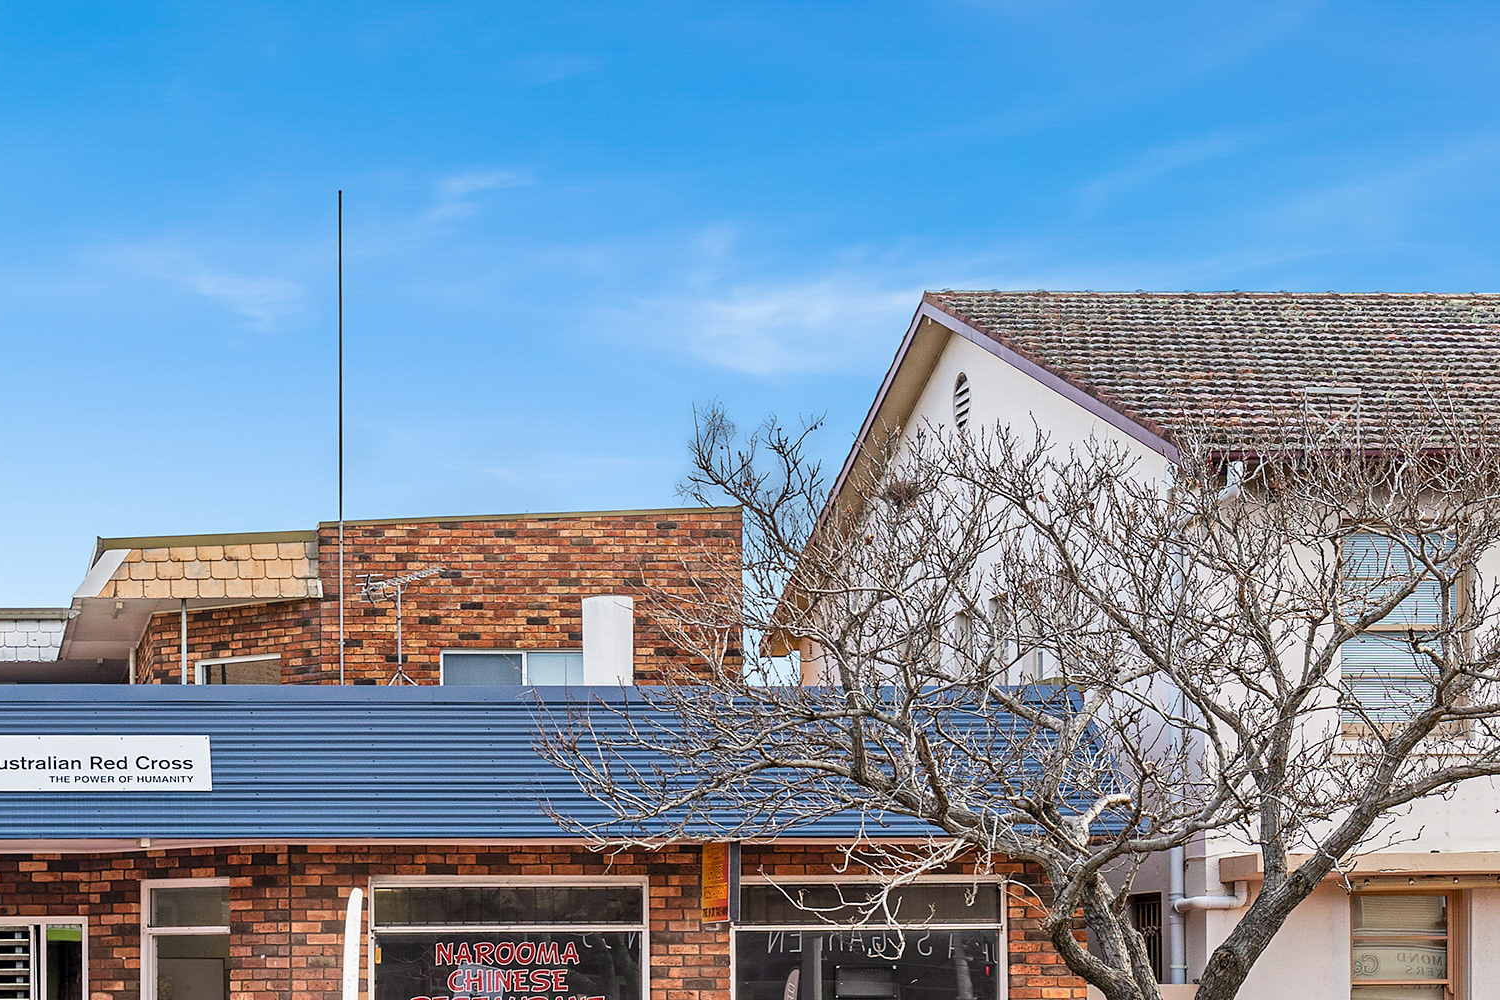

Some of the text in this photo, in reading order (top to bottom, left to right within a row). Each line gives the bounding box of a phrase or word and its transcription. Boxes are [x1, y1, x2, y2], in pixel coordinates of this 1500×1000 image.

[90, 756, 128, 770] Red
[135, 756, 194, 770] Cross
[435, 942, 581, 966] NAROOMA
[447, 968, 569, 993] CHINESE
